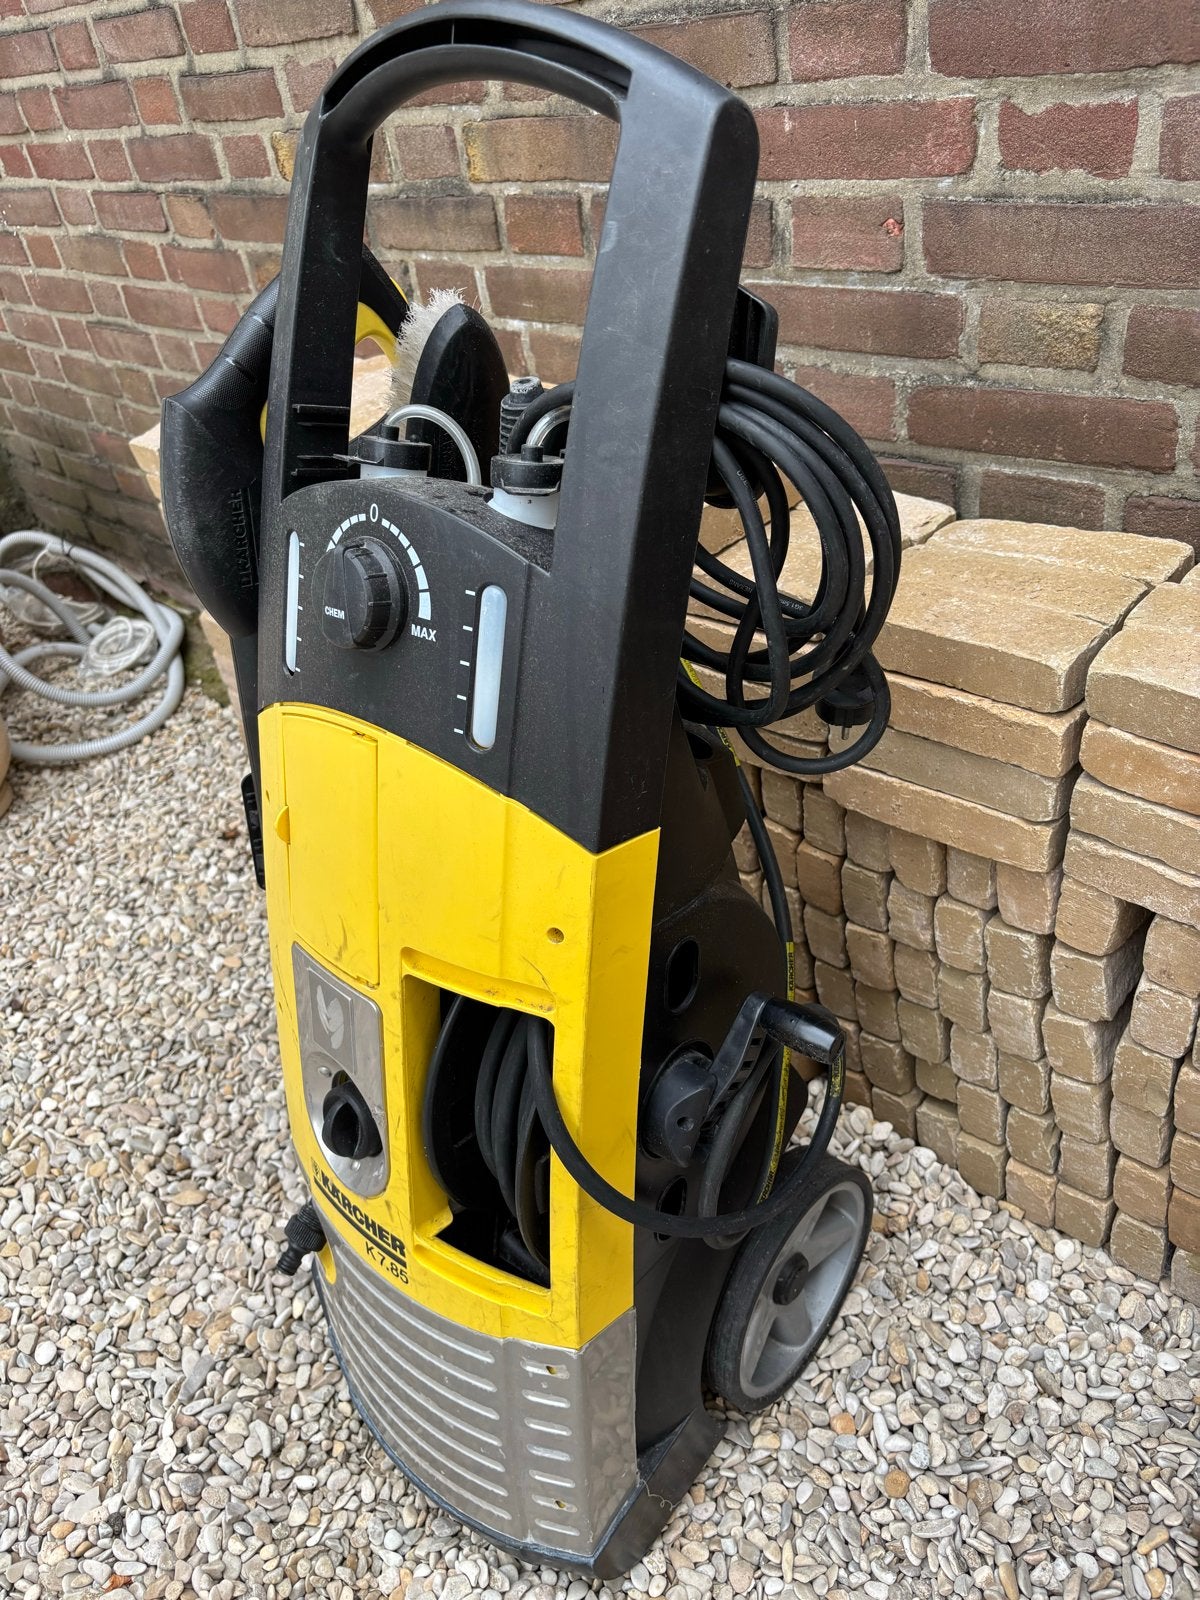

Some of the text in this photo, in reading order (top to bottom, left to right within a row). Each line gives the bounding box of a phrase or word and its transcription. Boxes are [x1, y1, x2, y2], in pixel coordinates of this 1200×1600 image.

[370, 503, 379, 523] 0
[324, 605, 345, 620] CHEM
[411, 623, 437, 642] MAX
